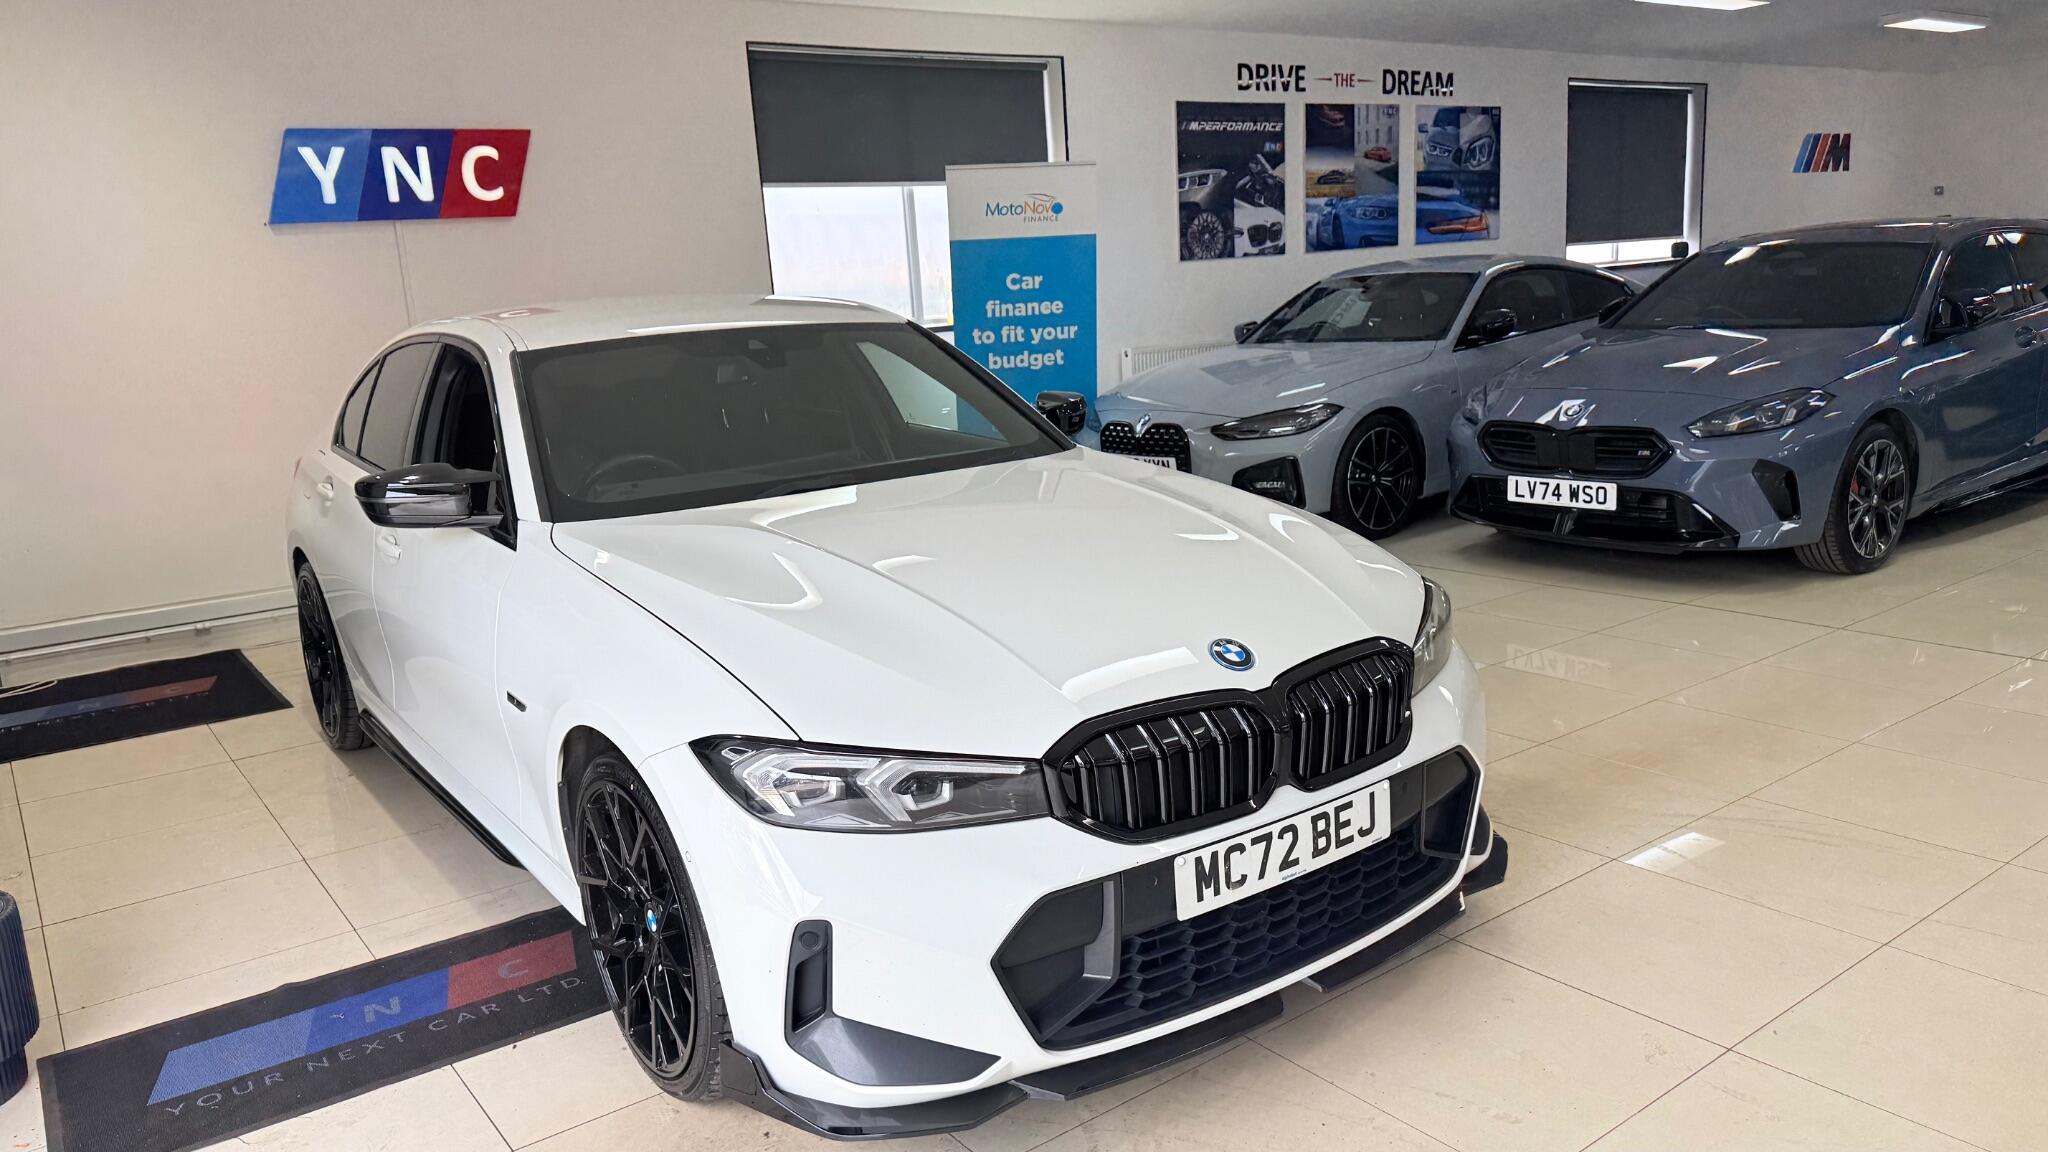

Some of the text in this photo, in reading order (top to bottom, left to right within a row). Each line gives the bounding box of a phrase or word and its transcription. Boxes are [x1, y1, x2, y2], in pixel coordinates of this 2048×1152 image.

[1237, 63, 1453, 96] DRIVE THE DREAM
[297, 145, 504, 204] YNC
[1023, 215, 1059, 223] FINANCE
[1005, 273, 1043, 290] Car
[985, 300, 1064, 318] finance
[972, 324, 1078, 345] to fit your
[988, 351, 1064, 369] budget
[1515, 480, 1607, 505] LV74 WSO
[1194, 791, 1375, 903] MC72 BEJ
[166, 1072, 284, 1115] YOUR
[306, 1031, 406, 1071] NEXT
[428, 1003, 500, 1031] CAR
